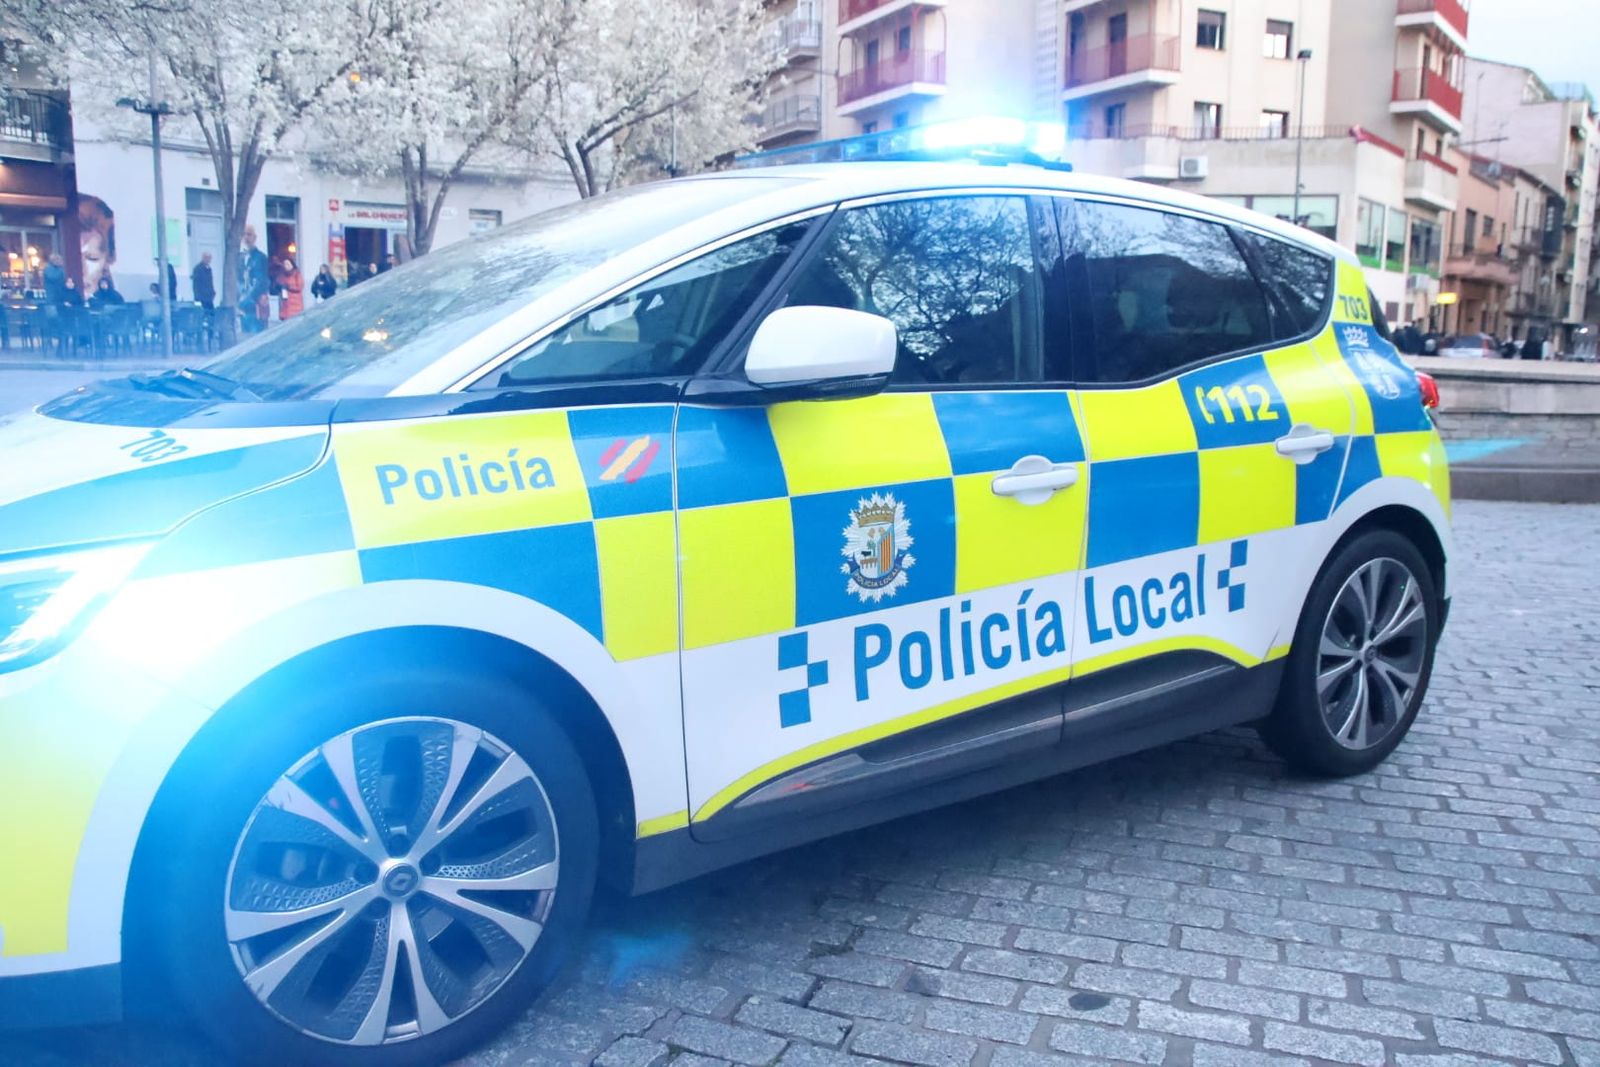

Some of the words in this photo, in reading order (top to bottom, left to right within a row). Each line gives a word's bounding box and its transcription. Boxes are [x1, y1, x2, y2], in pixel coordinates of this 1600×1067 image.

[1339, 295, 1368, 320] 703
[1207, 385, 1279, 423] 112
[119, 429, 189, 463] 703
[375, 448, 556, 506] Policía
[853, 588, 1067, 703] Policía
[1084, 553, 1208, 645] Local
